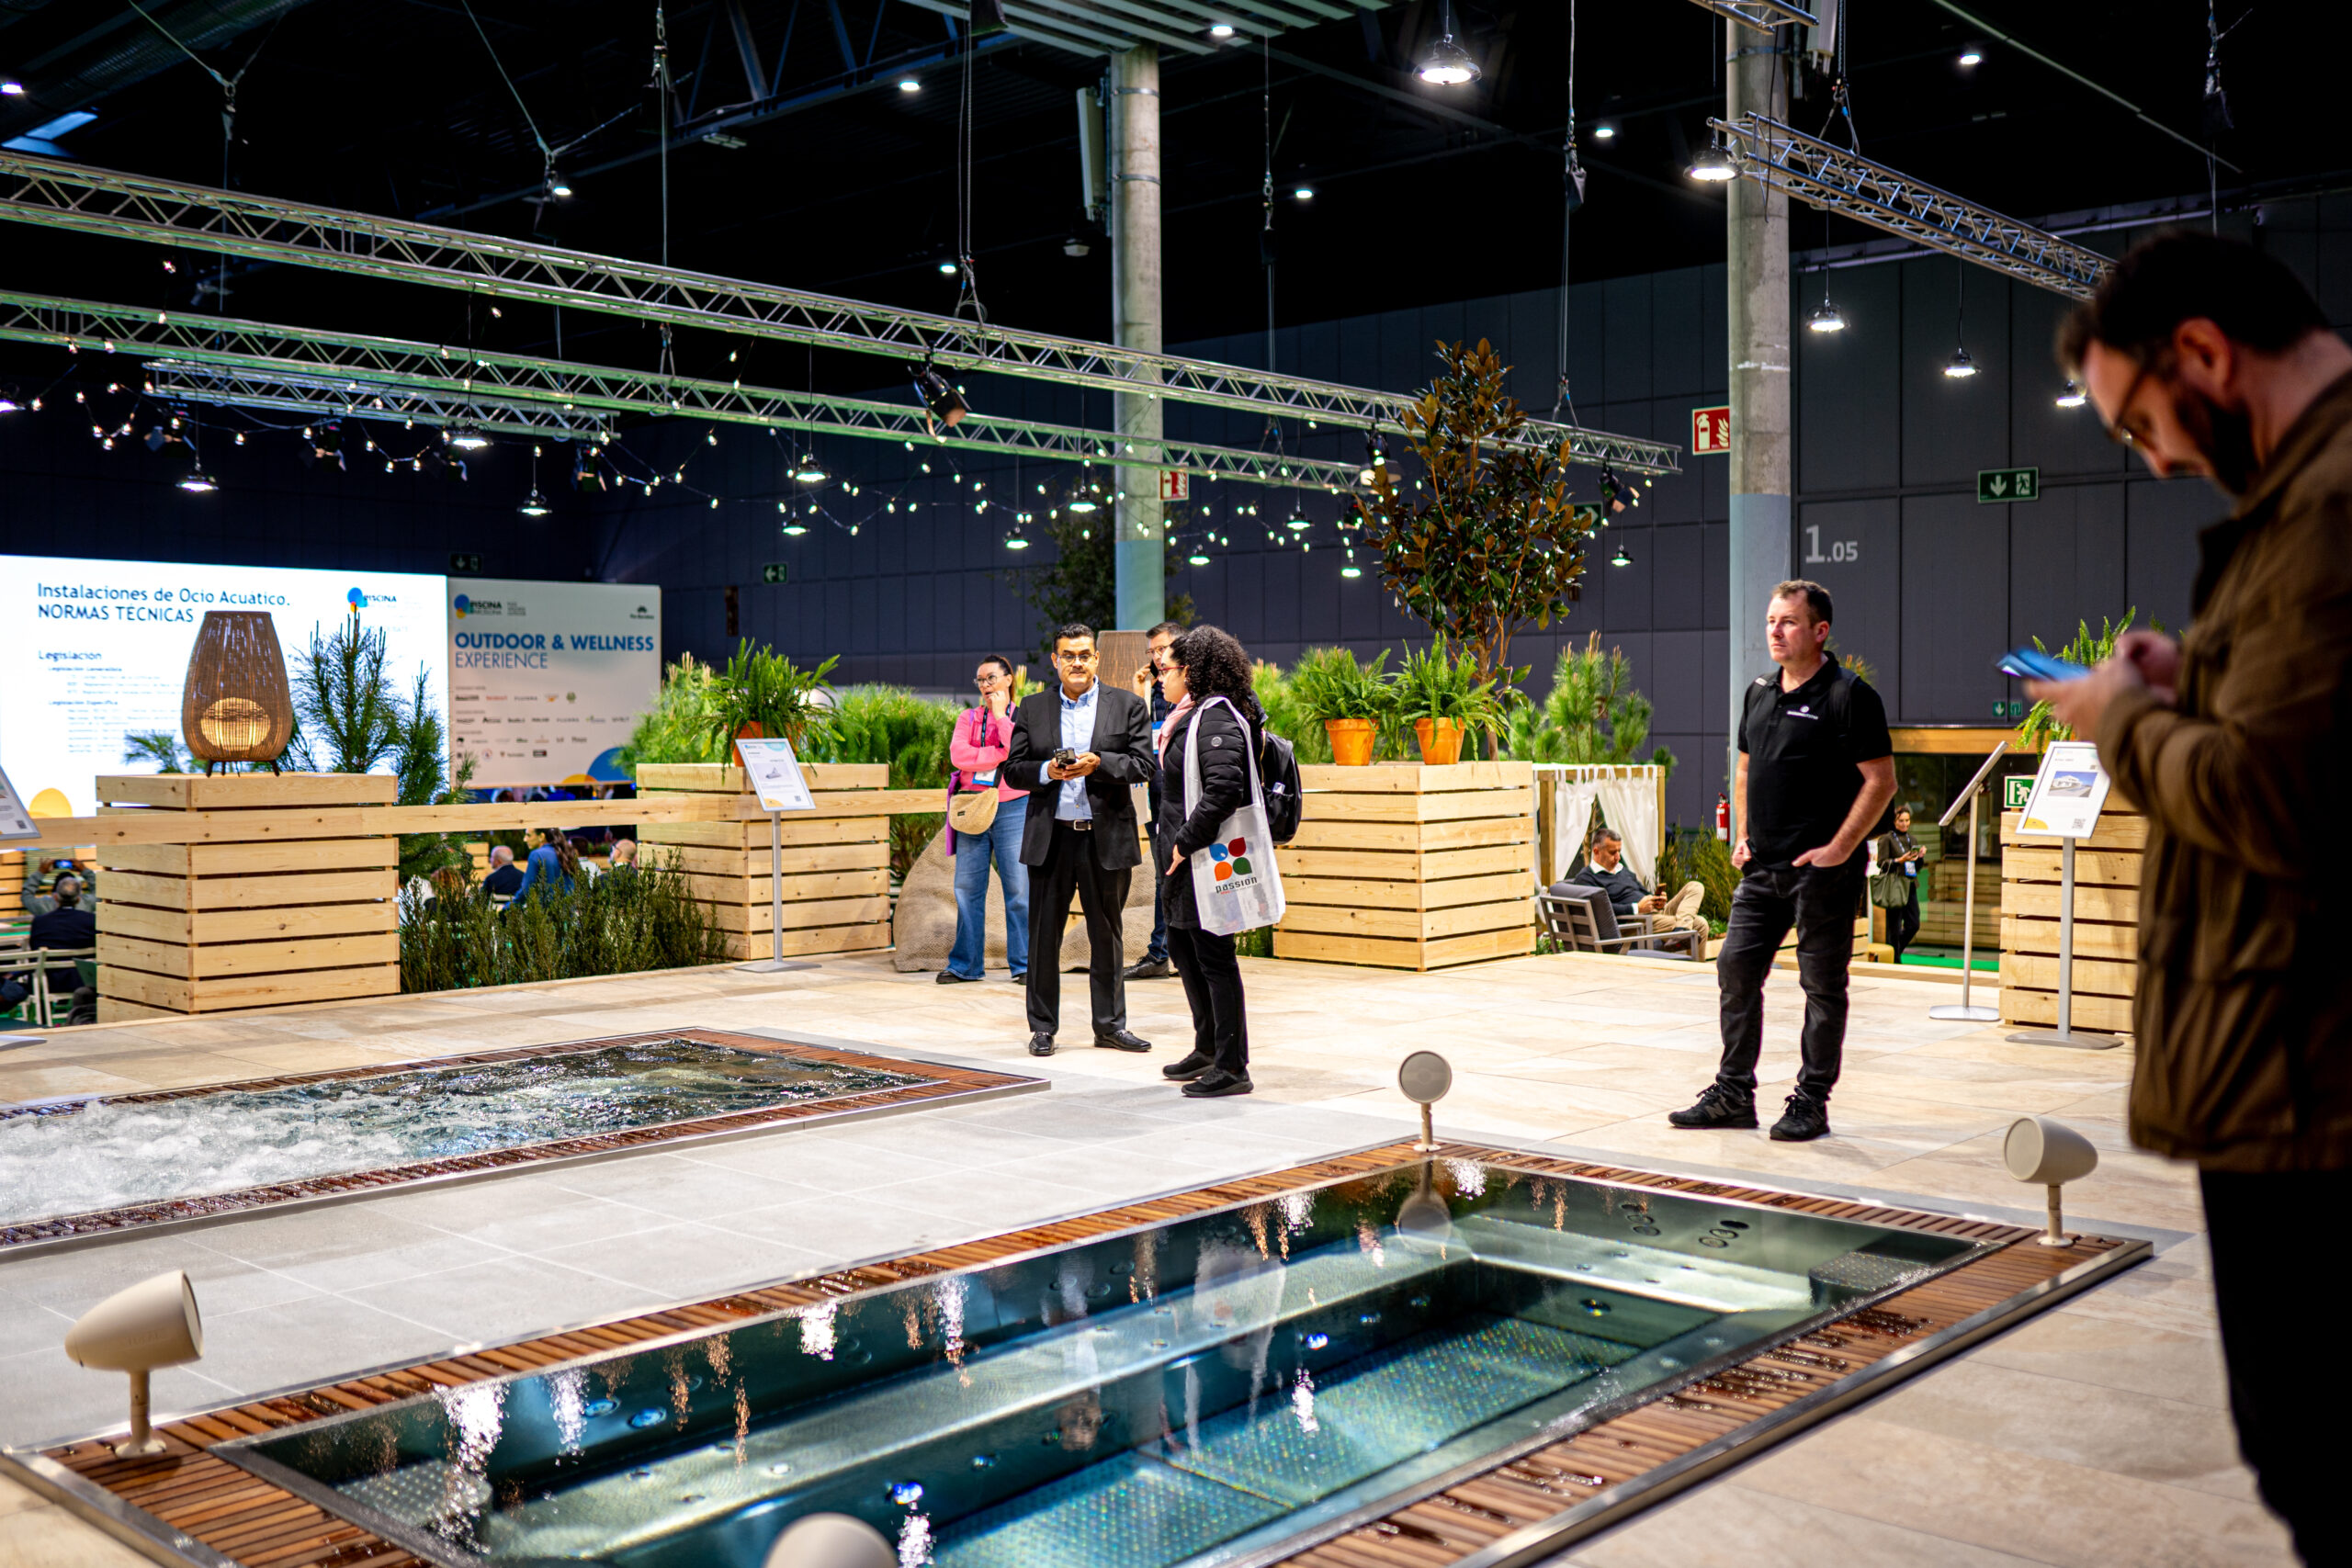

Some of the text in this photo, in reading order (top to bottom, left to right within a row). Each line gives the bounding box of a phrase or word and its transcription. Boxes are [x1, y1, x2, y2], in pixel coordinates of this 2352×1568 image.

[38, 582, 148, 601] Instalaciones
[153, 587, 173, 602] de
[179, 588, 214, 604] Ocio
[38, 604, 109, 620] NORMAS
[455, 632, 654, 651] OUTDOOR & WELLNESS
[456, 651, 548, 670] EXPERIENCE
[1216, 876, 1258, 894] passion
